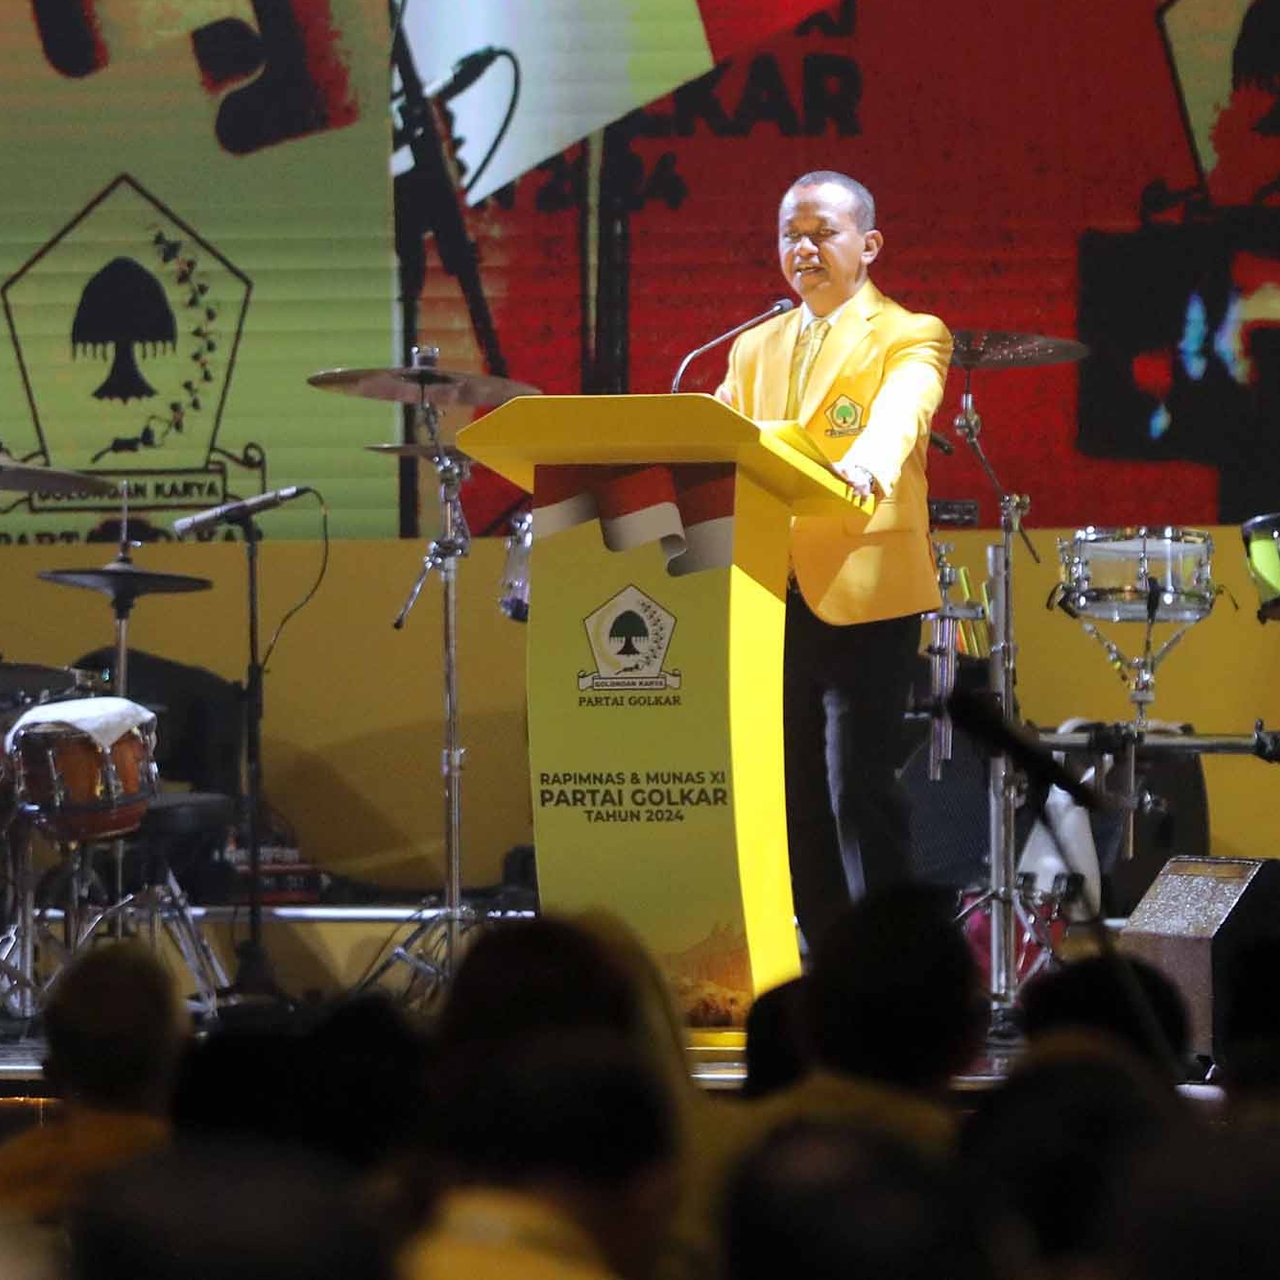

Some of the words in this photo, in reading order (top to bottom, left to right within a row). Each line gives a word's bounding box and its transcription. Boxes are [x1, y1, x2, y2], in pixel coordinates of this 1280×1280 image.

[578, 696, 625, 708] PARTAI
[628, 695, 682, 707] GOLKAR
[540, 772, 625, 786] RAPIMNAS
[631, 773, 641, 785] &
[646, 772, 706, 785] MUNAS
[710, 772, 726, 784] XI
[540, 788, 624, 808] PARTAI
[631, 788, 728, 807] GOLKAR
[584, 809, 641, 823] TAHUN
[646, 809, 685, 823] 2024
